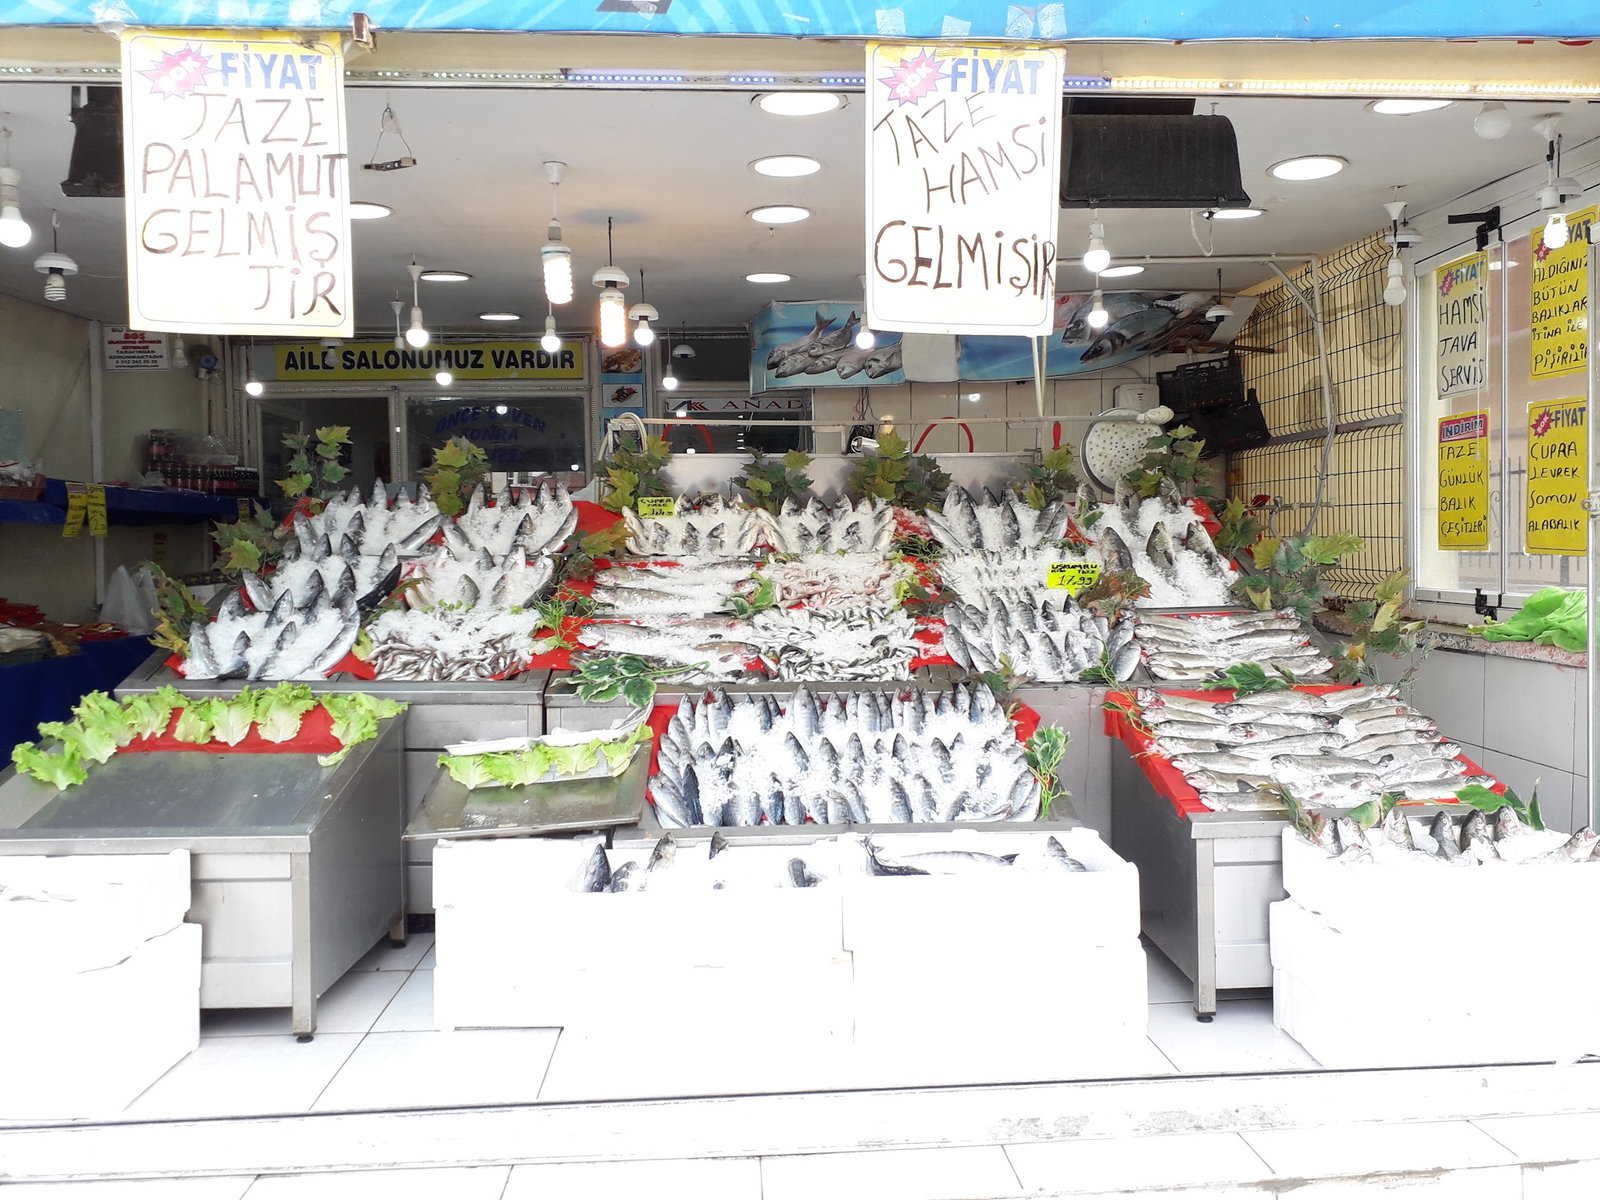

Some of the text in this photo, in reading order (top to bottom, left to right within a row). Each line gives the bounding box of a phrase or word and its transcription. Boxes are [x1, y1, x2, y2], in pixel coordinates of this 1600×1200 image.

[159, 43, 322, 90] OK FİYAT
[950, 49, 1044, 94] FİYAT
[873, 91, 997, 166] TAZE
[142, 142, 348, 204] PALAMUT
[922, 116, 1046, 214] HAMSİ
[141, 205, 339, 268] GELMİŞ
[874, 219, 1056, 300] GELMİŞİR
[1454, 261, 1485, 285] FİYAT
[1533, 278, 1579, 306] BÜTÜN
[1439, 286, 1485, 325] HAMSİ
[1566, 318, 1583, 332] İLE
[342, 349, 485, 371] SALONUMUZ
[491, 349, 575, 369] VARDIR
[1441, 357, 1484, 393] SERVİS
[1442, 417, 1484, 439] İNDİRİM
[1536, 403, 1587, 434] ŞOK FİYAT
[1440, 442, 1477, 460] TAZE
[1530, 440, 1578, 461] ÇUPRA
[1439, 465, 1484, 488] GÜNLÜK
[1529, 466, 1580, 480] LEVREK
[1440, 496, 1476, 512] BALIK
[1528, 489, 1577, 509] SOMON
[1440, 514, 1487, 539] ÇEŞİTLERİ
[1528, 518, 1580, 532] ALABALIK
